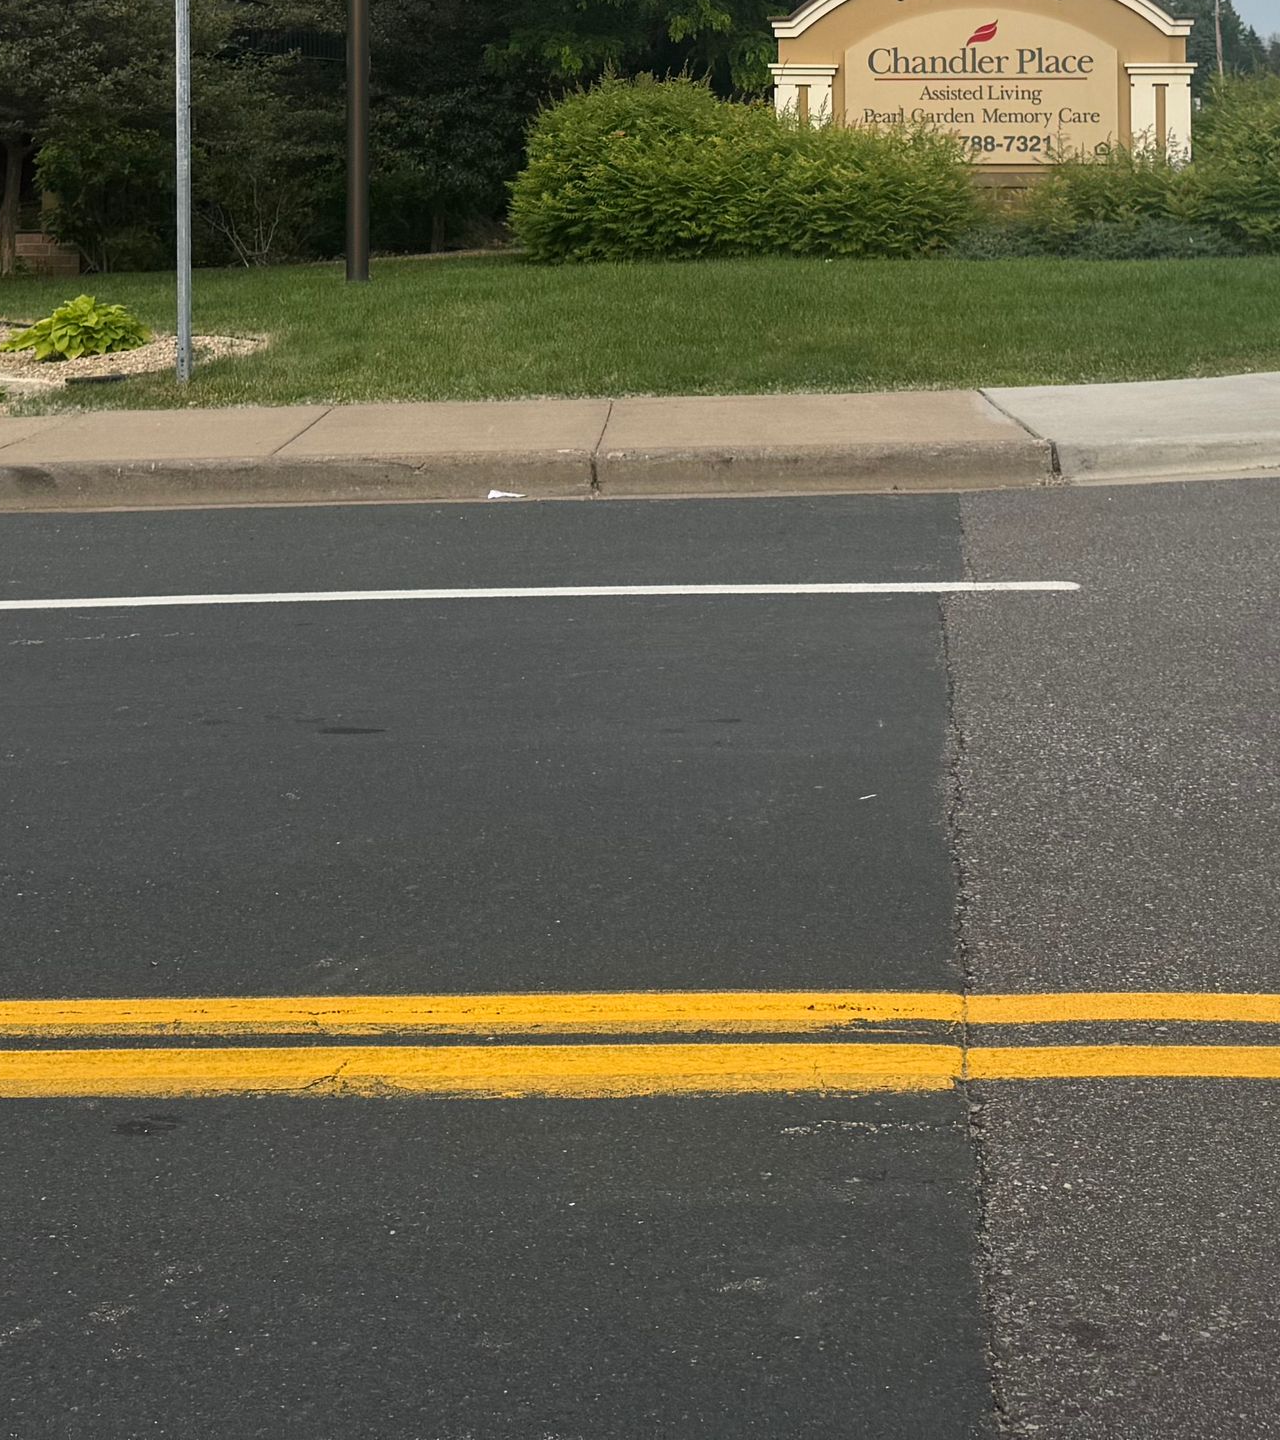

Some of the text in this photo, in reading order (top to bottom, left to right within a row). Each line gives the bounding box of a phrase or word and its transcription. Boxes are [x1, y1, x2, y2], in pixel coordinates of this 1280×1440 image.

[868, 47, 1094, 74] Chandler Place
[919, 85, 1043, 105] Assisted Living
[863, 107, 1101, 129] Pearl Garden Memory Care
